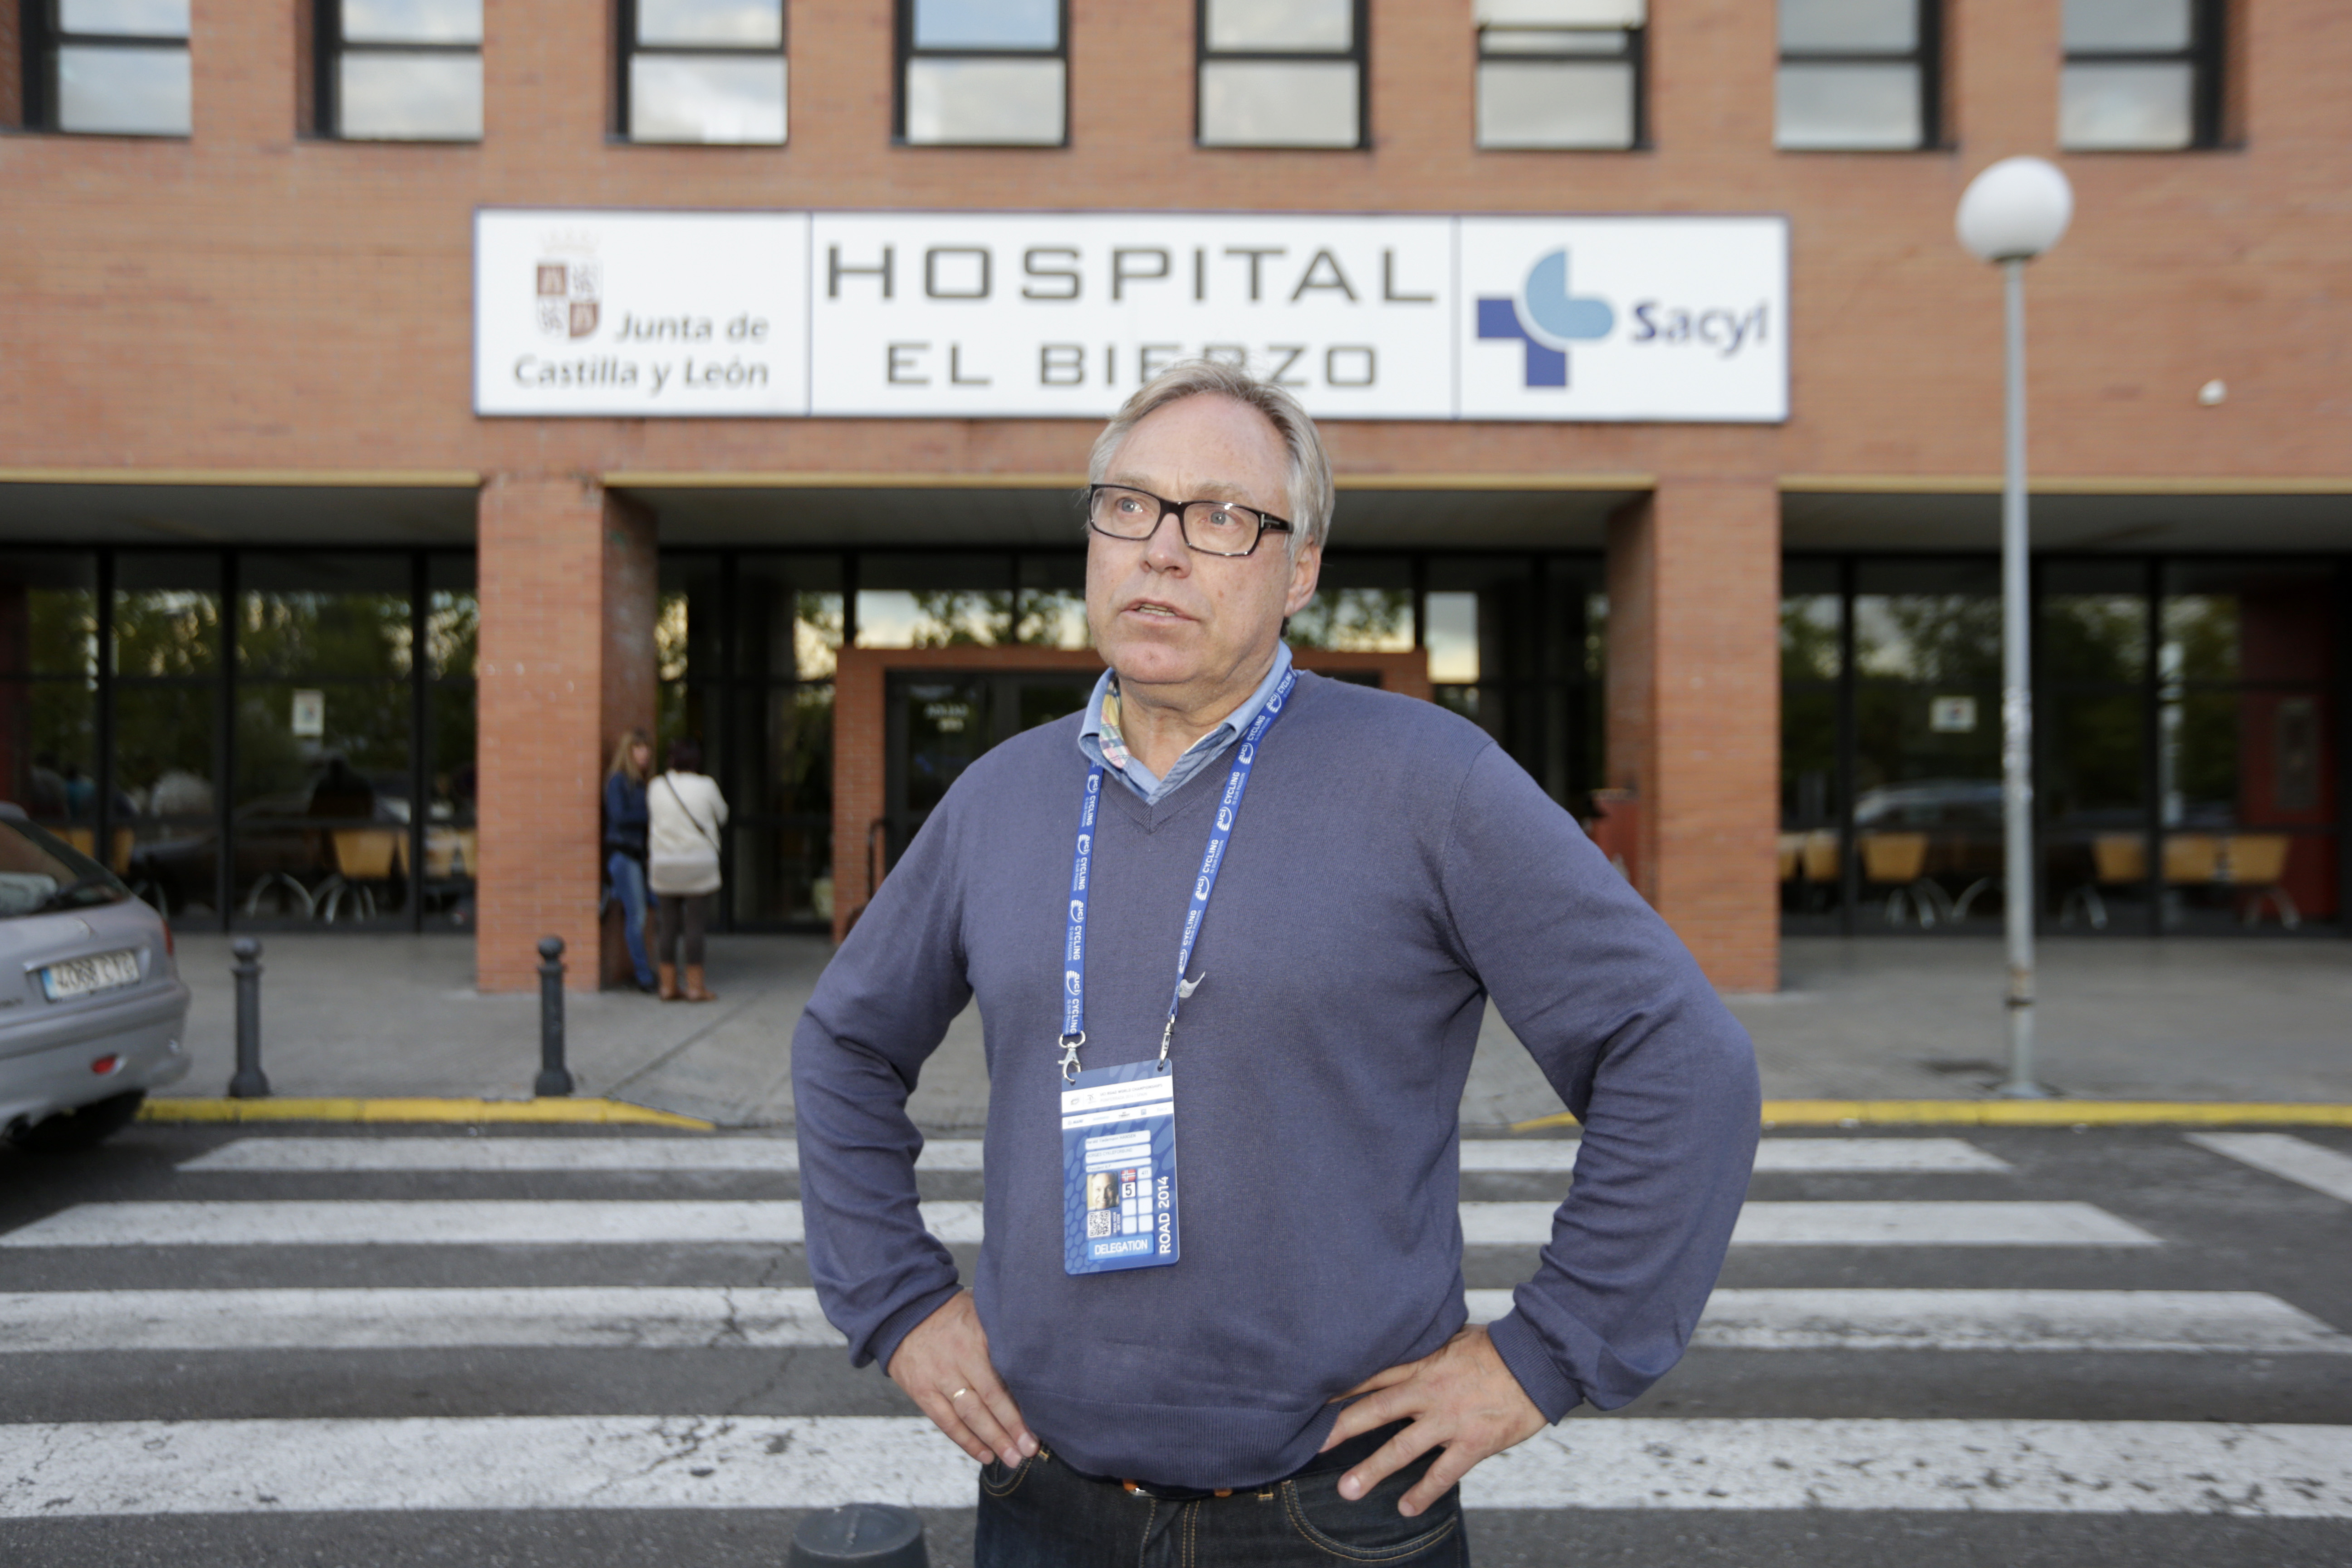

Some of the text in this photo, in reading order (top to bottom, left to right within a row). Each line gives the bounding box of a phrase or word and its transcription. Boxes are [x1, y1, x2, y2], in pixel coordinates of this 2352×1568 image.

[827, 246, 1435, 303] HOSPITAL
[615, 311, 768, 342] Junta de
[1632, 299, 1769, 359] Sacyl
[514, 354, 769, 397] Castilla y León
[887, 343, 994, 386] EL
[1247, 715, 1265, 740] CYCLING
[1224, 771, 1240, 804] CYCLING
[1086, 795, 1096, 826] CYCLING
[1202, 839, 1219, 873] CYCLING
[1078, 857, 1088, 891] CYCLING
[1073, 925, 1082, 960] CYCLING
[1183, 910, 1197, 946] CYCLING
[1070, 998, 1079, 1034] CYCLING
[1125, 1184, 1132, 1196] 5
[1157, 1176, 1171, 1254] ROAD 2014
[1094, 1239, 1148, 1255] DELEGATION
